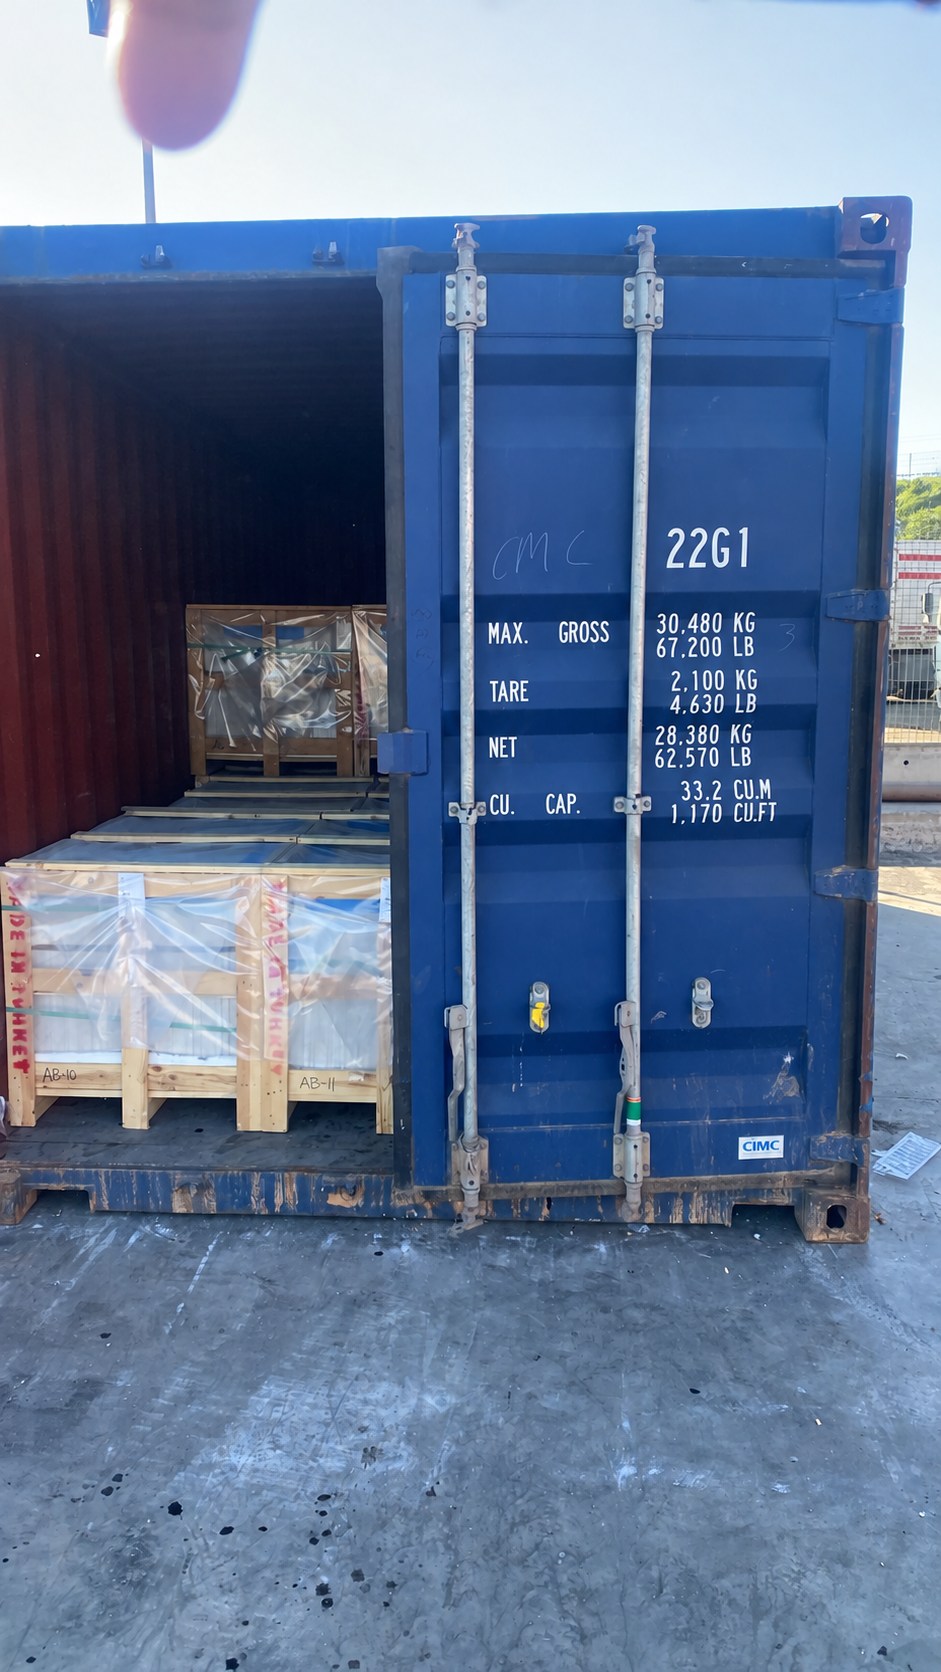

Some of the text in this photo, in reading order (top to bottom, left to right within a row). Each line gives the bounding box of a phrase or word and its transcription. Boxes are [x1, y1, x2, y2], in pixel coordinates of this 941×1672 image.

[666, 527, 749, 569] 22G1
[488, 612, 756, 644] MAX. GROSS 30,480 KG
[656, 636, 755, 659] 67,200 LB
[490, 669, 758, 702] TARE 2,100 KG
[670, 693, 757, 714] 4,630 LB
[489, 723, 752, 758] NET 28,380 KG
[731, 747, 751, 767] LB
[490, 779, 771, 815] CU. CAP. 33.2 CU.M
[671, 802, 777, 825] 1,170 CU.FT
[300, 1077, 336, 1092] AB-11
[742, 1139, 780, 1152] CIMC
